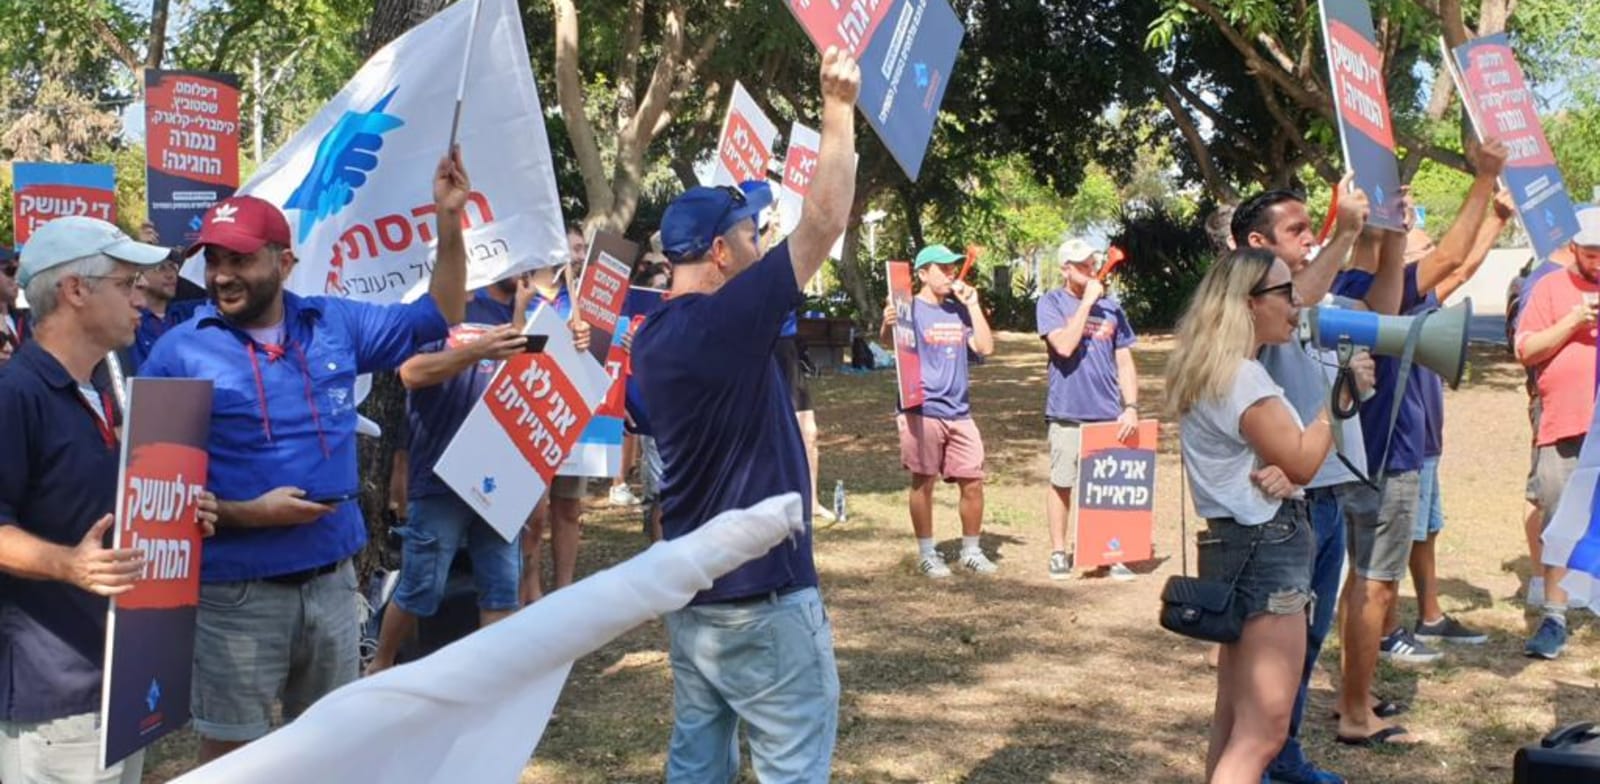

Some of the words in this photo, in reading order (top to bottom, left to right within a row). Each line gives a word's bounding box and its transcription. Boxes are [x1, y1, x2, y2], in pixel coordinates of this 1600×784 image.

[169, 129, 217, 152] נגמרה
[162, 149, 222, 176] החגיגה!
[20, 194, 88, 217] לעושק
[91, 202, 111, 220] די
[467, 238, 509, 265] הבי
[519, 359, 551, 398] לא
[495, 374, 563, 468] פראיירית!
[547, 390, 577, 437] אני
[1093, 454, 1118, 479] לא
[1120, 459, 1147, 480] אני
[125, 473, 186, 532] לעושק
[1085, 481, 1149, 506] פראייר!
